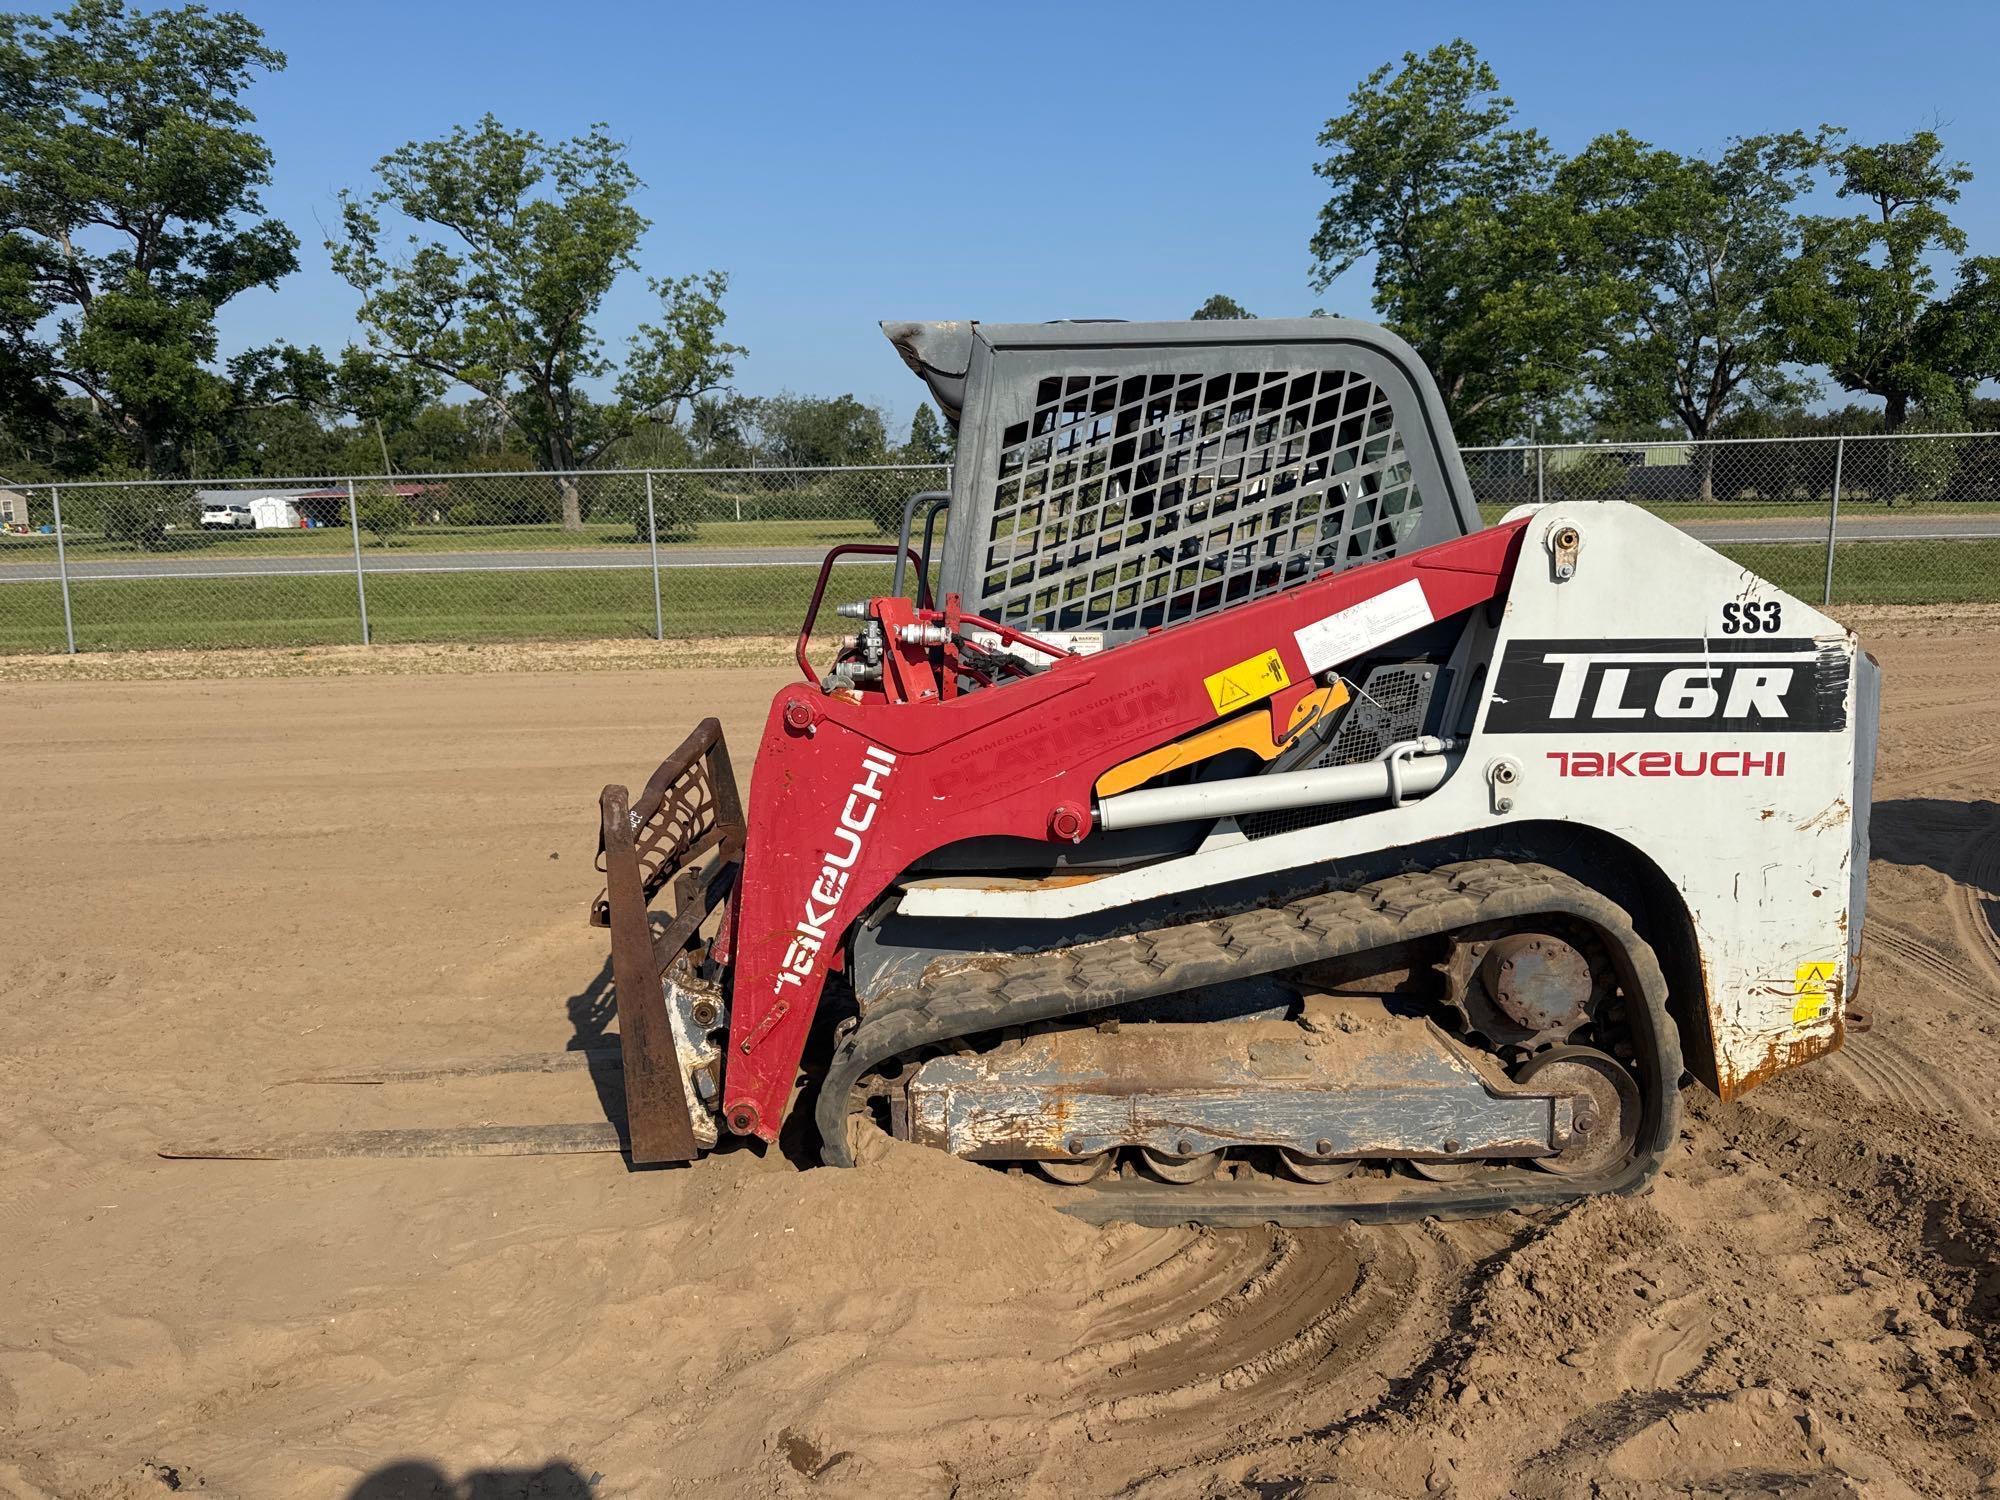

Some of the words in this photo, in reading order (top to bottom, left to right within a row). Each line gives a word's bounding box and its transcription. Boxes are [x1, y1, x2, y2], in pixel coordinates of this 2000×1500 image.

[1722, 601, 1782, 634] SS3
[1543, 651, 1814, 719] TL6R
[951, 722, 1047, 763] COMMERCIAL
[1069, 679, 1157, 718] RESIDENTIAL
